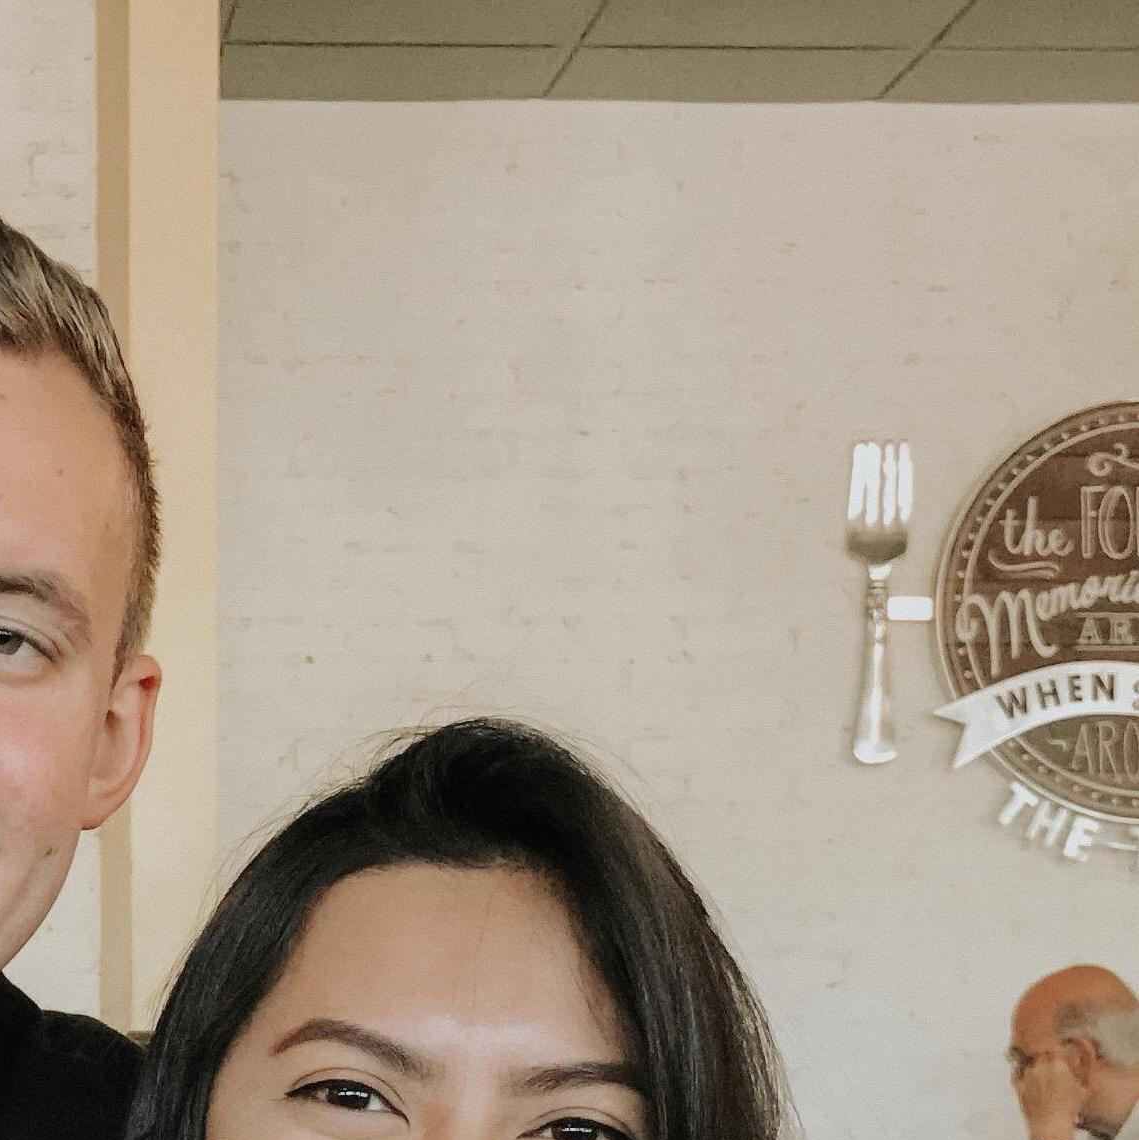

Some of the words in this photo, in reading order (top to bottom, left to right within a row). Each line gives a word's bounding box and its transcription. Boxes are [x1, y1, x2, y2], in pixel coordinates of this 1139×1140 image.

[998, 495, 1075, 557] the
[1079, 485, 1139, 561] FO
[955, 568, 1139, 678] Memori
[996, 673, 1117, 719] WHEN
[998, 781, 1100, 862] THE
